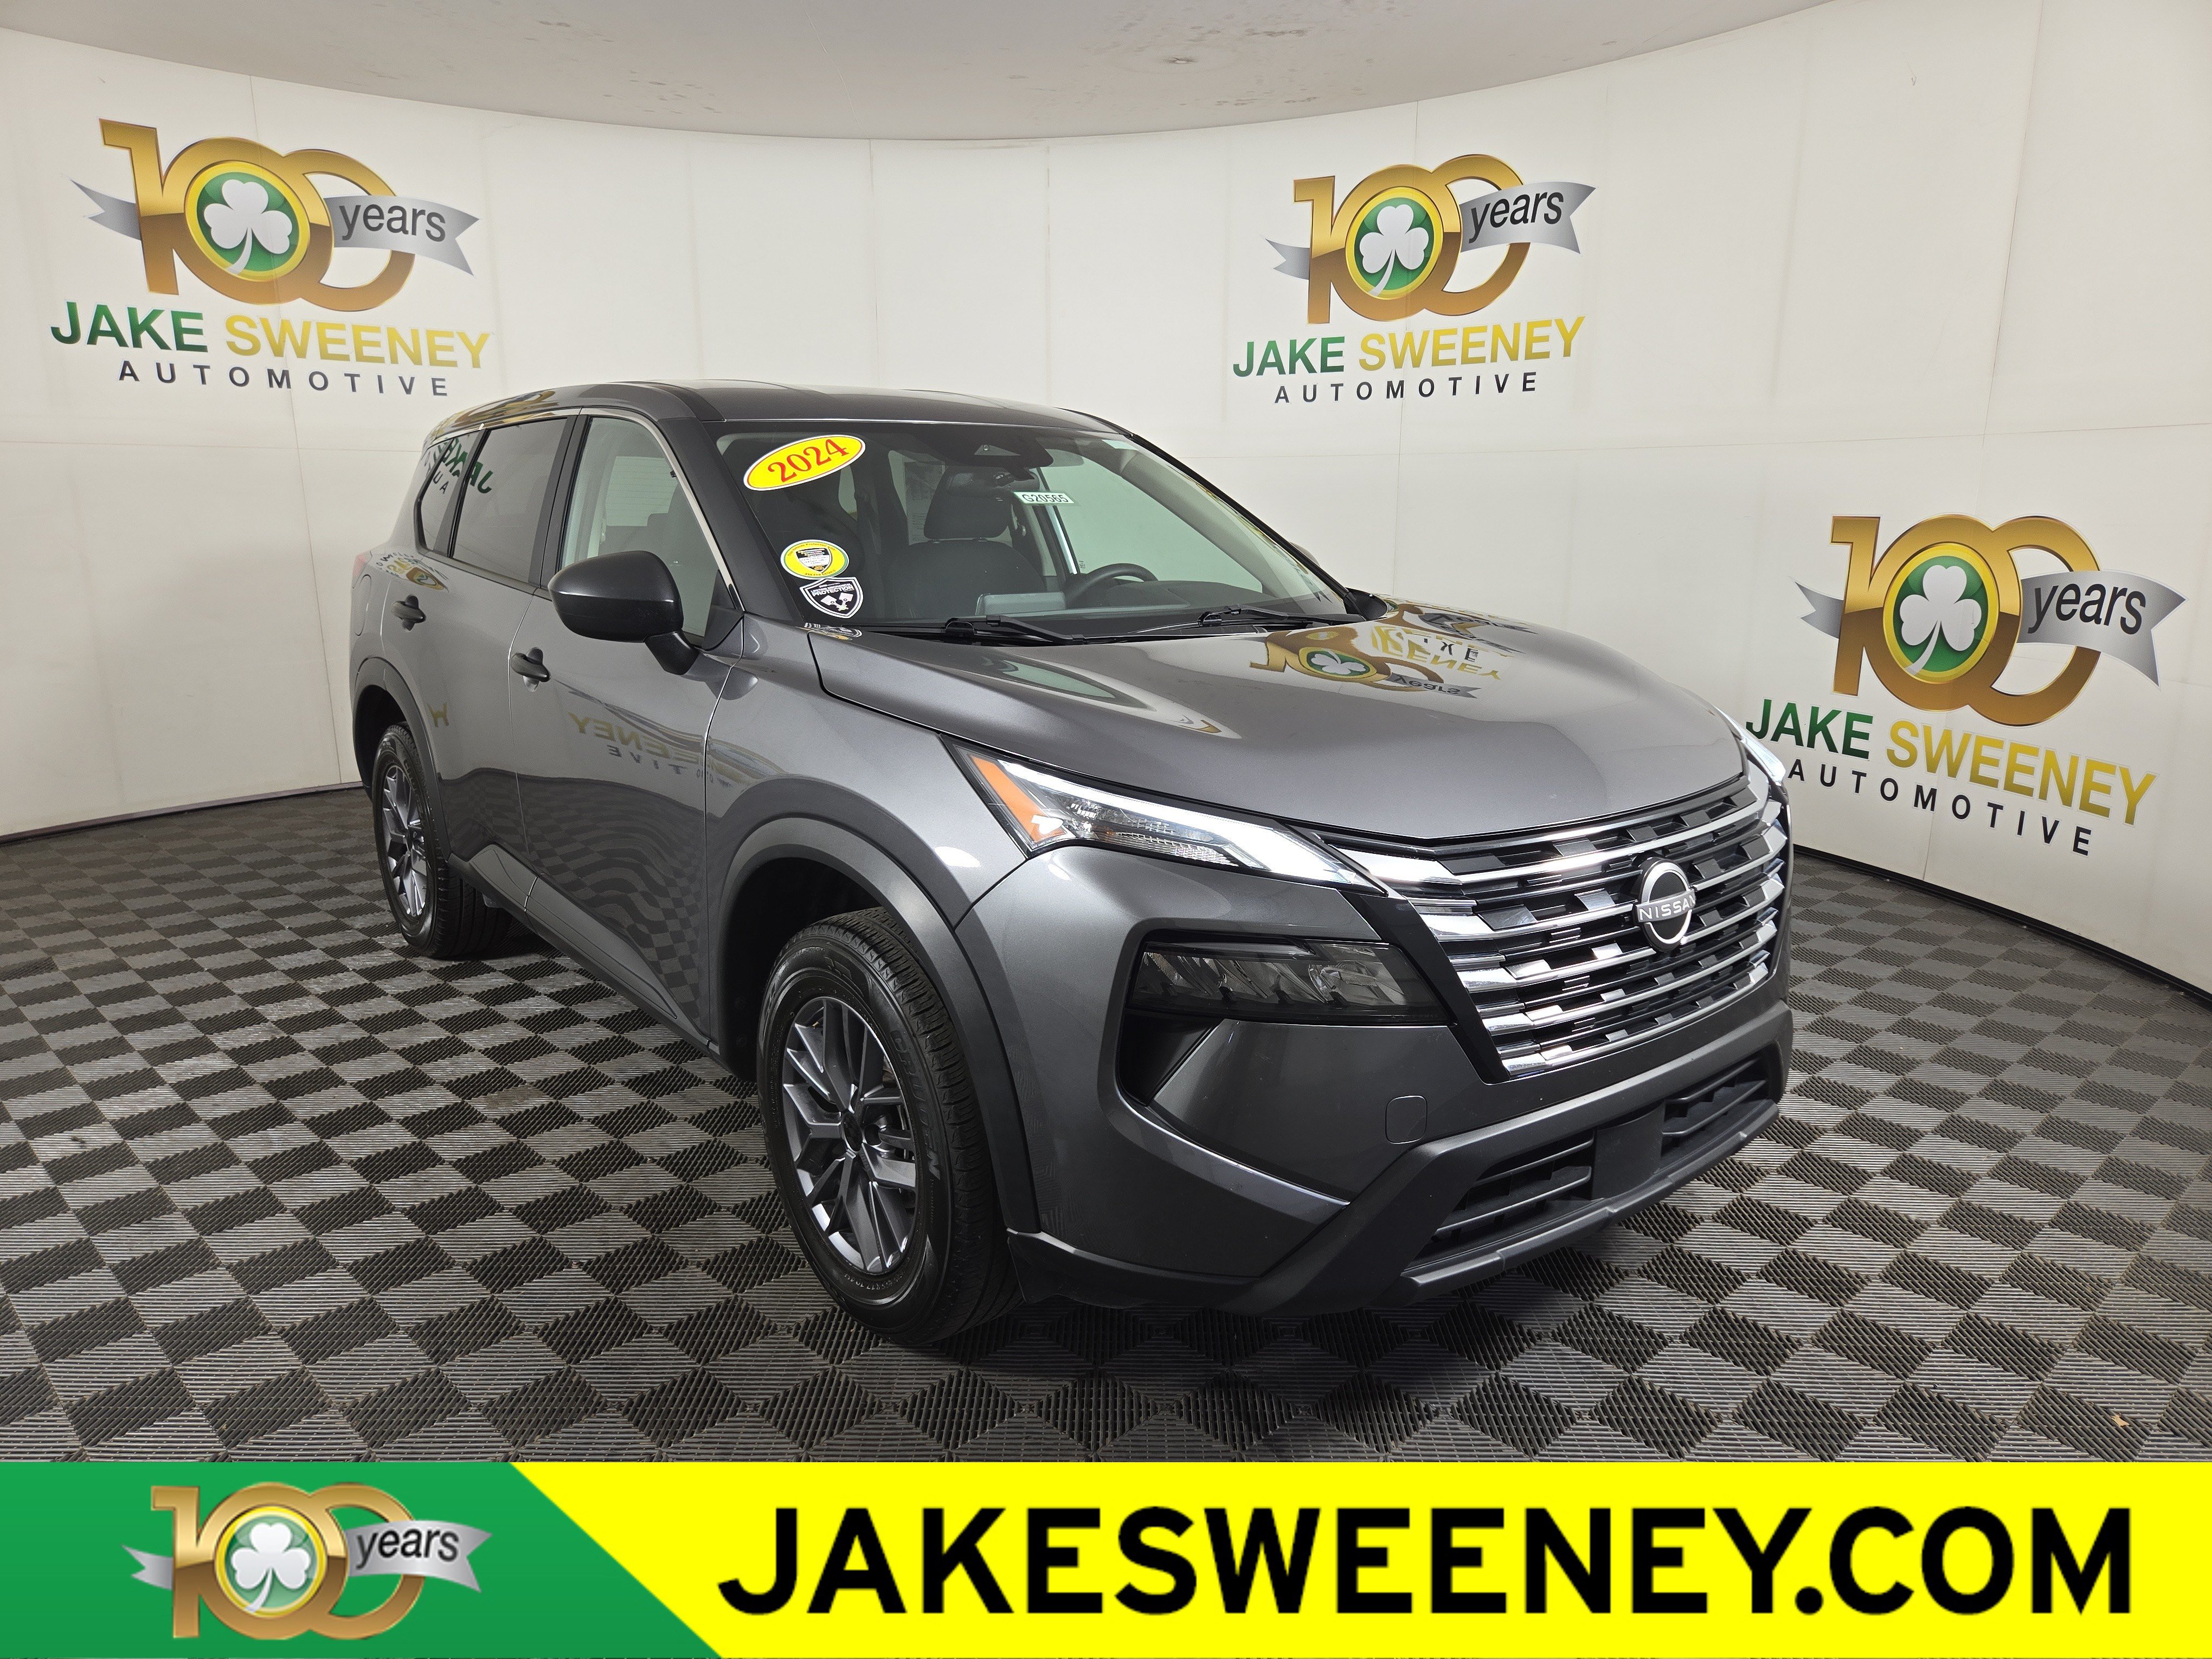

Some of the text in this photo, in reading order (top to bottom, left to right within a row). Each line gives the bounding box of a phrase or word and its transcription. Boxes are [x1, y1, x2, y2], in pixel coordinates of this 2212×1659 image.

[339, 203, 446, 242] years
[1468, 191, 1564, 244] years
[50, 301, 490, 369] JAKE SWEENEY
[1233, 316, 1586, 377] JAKE SWEENEY
[119, 360, 448, 397] AUTOMOTIVE
[1274, 372, 1537, 404] AUTOMOTIVE
[768, 439, 850, 483] 2024
[1021, 494, 1069, 503] G20565
[2027, 583, 2146, 635] years
[1746, 699, 2158, 826] JAKE SWEENEY
[1787, 759, 2092, 856] AUTOMOTIVE
[1638, 895, 1696, 921] NISSAN
